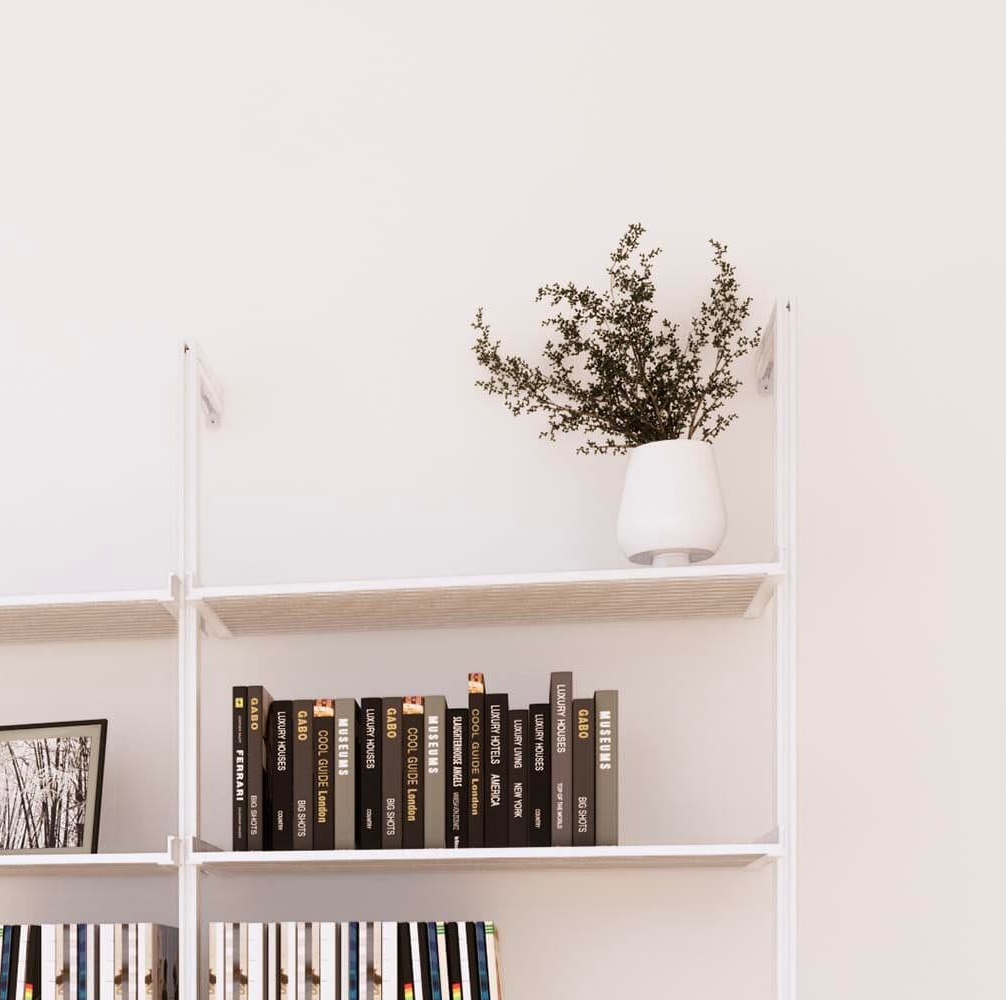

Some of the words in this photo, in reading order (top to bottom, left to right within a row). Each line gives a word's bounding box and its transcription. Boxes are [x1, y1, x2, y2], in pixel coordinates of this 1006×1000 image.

[557, 684, 566, 718] LUXURY
[278, 711, 286, 740] LUXURY
[298, 710, 308, 741] GABO
[367, 709, 375, 737] LUXURY
[387, 708, 397, 738] GABO
[471, 708, 479, 738] COOL
[490, 705, 500, 733] LUXURY
[514, 719, 522, 745] LUXURY
[535, 714, 544, 741] LUXURY
[578, 709, 589, 738] GABO
[318, 730, 328, 756] COOL
[338, 719, 348, 776] MUSEUMS
[408, 728, 418, 753] COOL
[428, 716, 438, 774] MUSEUMS
[453, 717, 462, 765] SLAUGHTERHOUSE
[490, 735, 500, 765] HOTELS
[557, 719, 566, 753] HOUSES
[599, 711, 611, 770] MUSEUMS
[278, 741, 286, 771] HOUSES
[367, 739, 375, 769] HOUSES
[471, 741, 479, 774] GUIDE
[514, 747, 522, 769] LIVING
[535, 743, 544, 771] HOUSES
[236, 750, 244, 801] FERRARI
[318, 759, 328, 787] GUIDE
[408, 757, 418, 785] GUIDE
[453, 766, 462, 787] ANGELS
[490, 774, 500, 806] AMERICA
[514, 782, 522, 798] NEW
[578, 797, 587, 809] BIG
[298, 800, 306, 812] BIG
[318, 791, 328, 823] London
[387, 798, 395, 811] BIG
[408, 789, 418, 821] London
[514, 799, 522, 818] YORK
[298, 813, 306, 837] SHOTS
[387, 812, 395, 835] SHOTS
[578, 811, 587, 833] SHOTS
